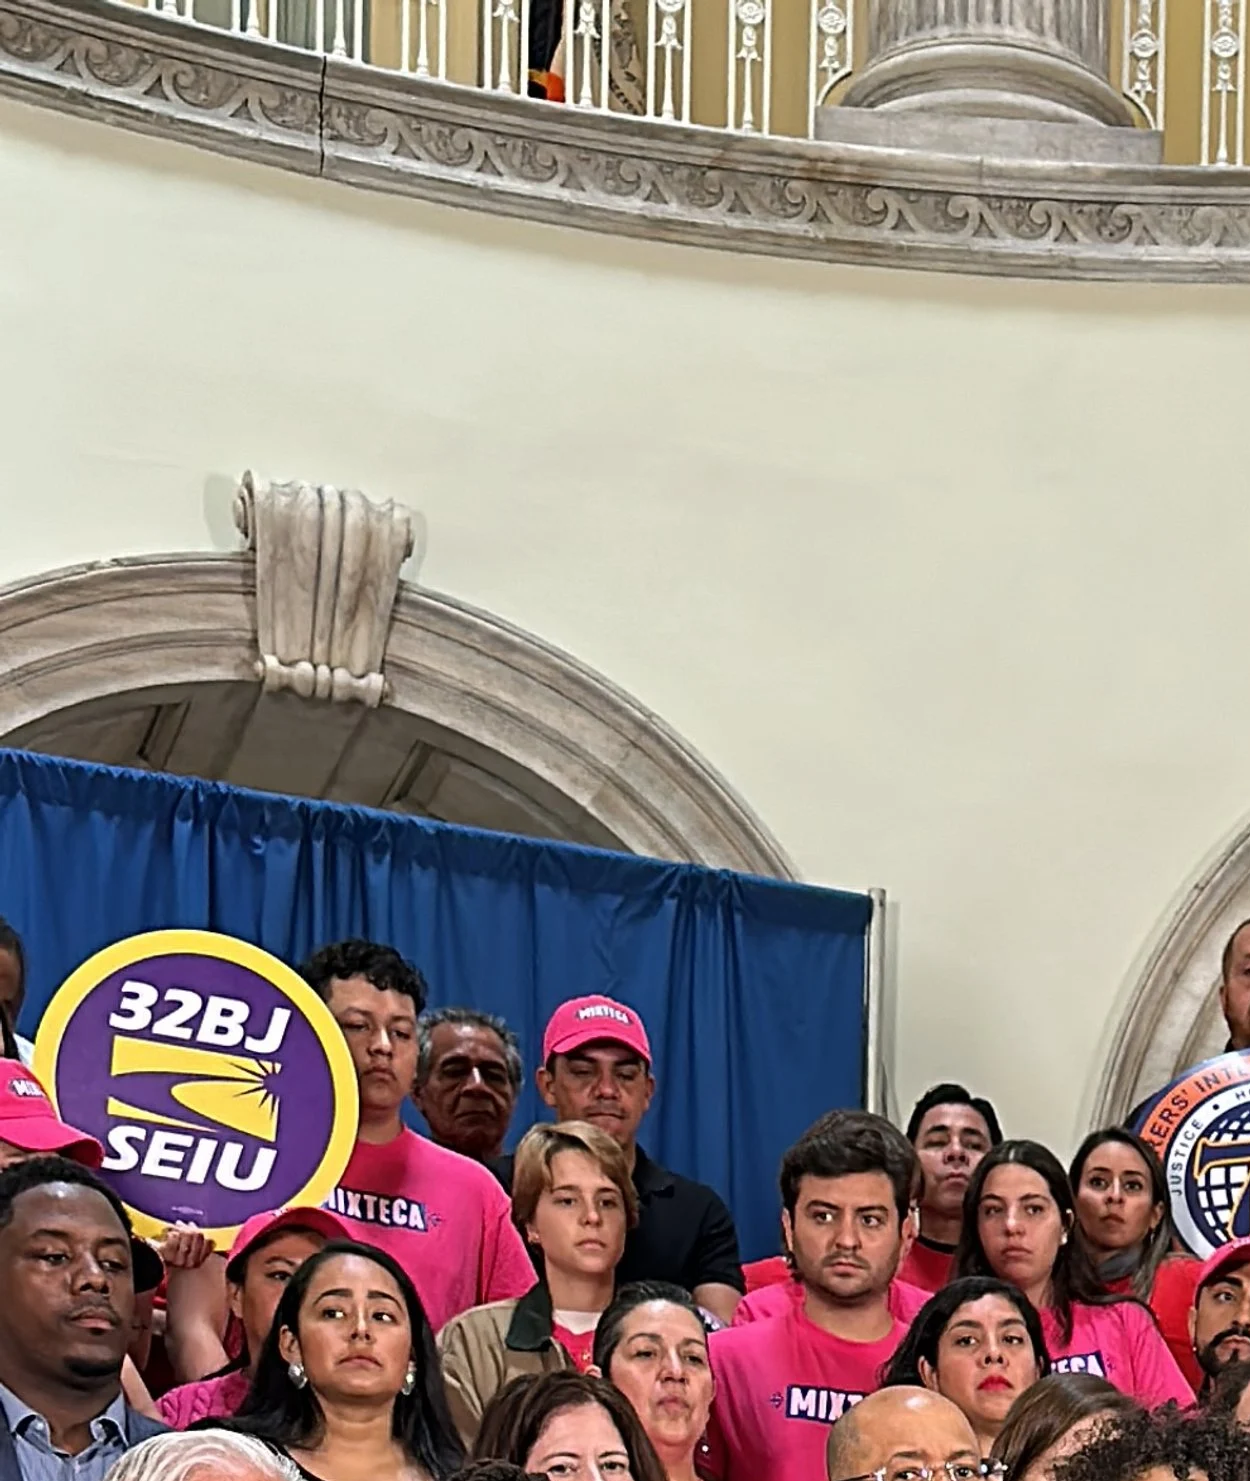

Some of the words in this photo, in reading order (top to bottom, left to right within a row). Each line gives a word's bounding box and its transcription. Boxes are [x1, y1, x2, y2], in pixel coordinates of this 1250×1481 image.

[109, 980, 292, 1053] 32BJ
[101, 1125, 277, 1192] SEIU
[1169, 1119, 1204, 1197] JUSTICE
